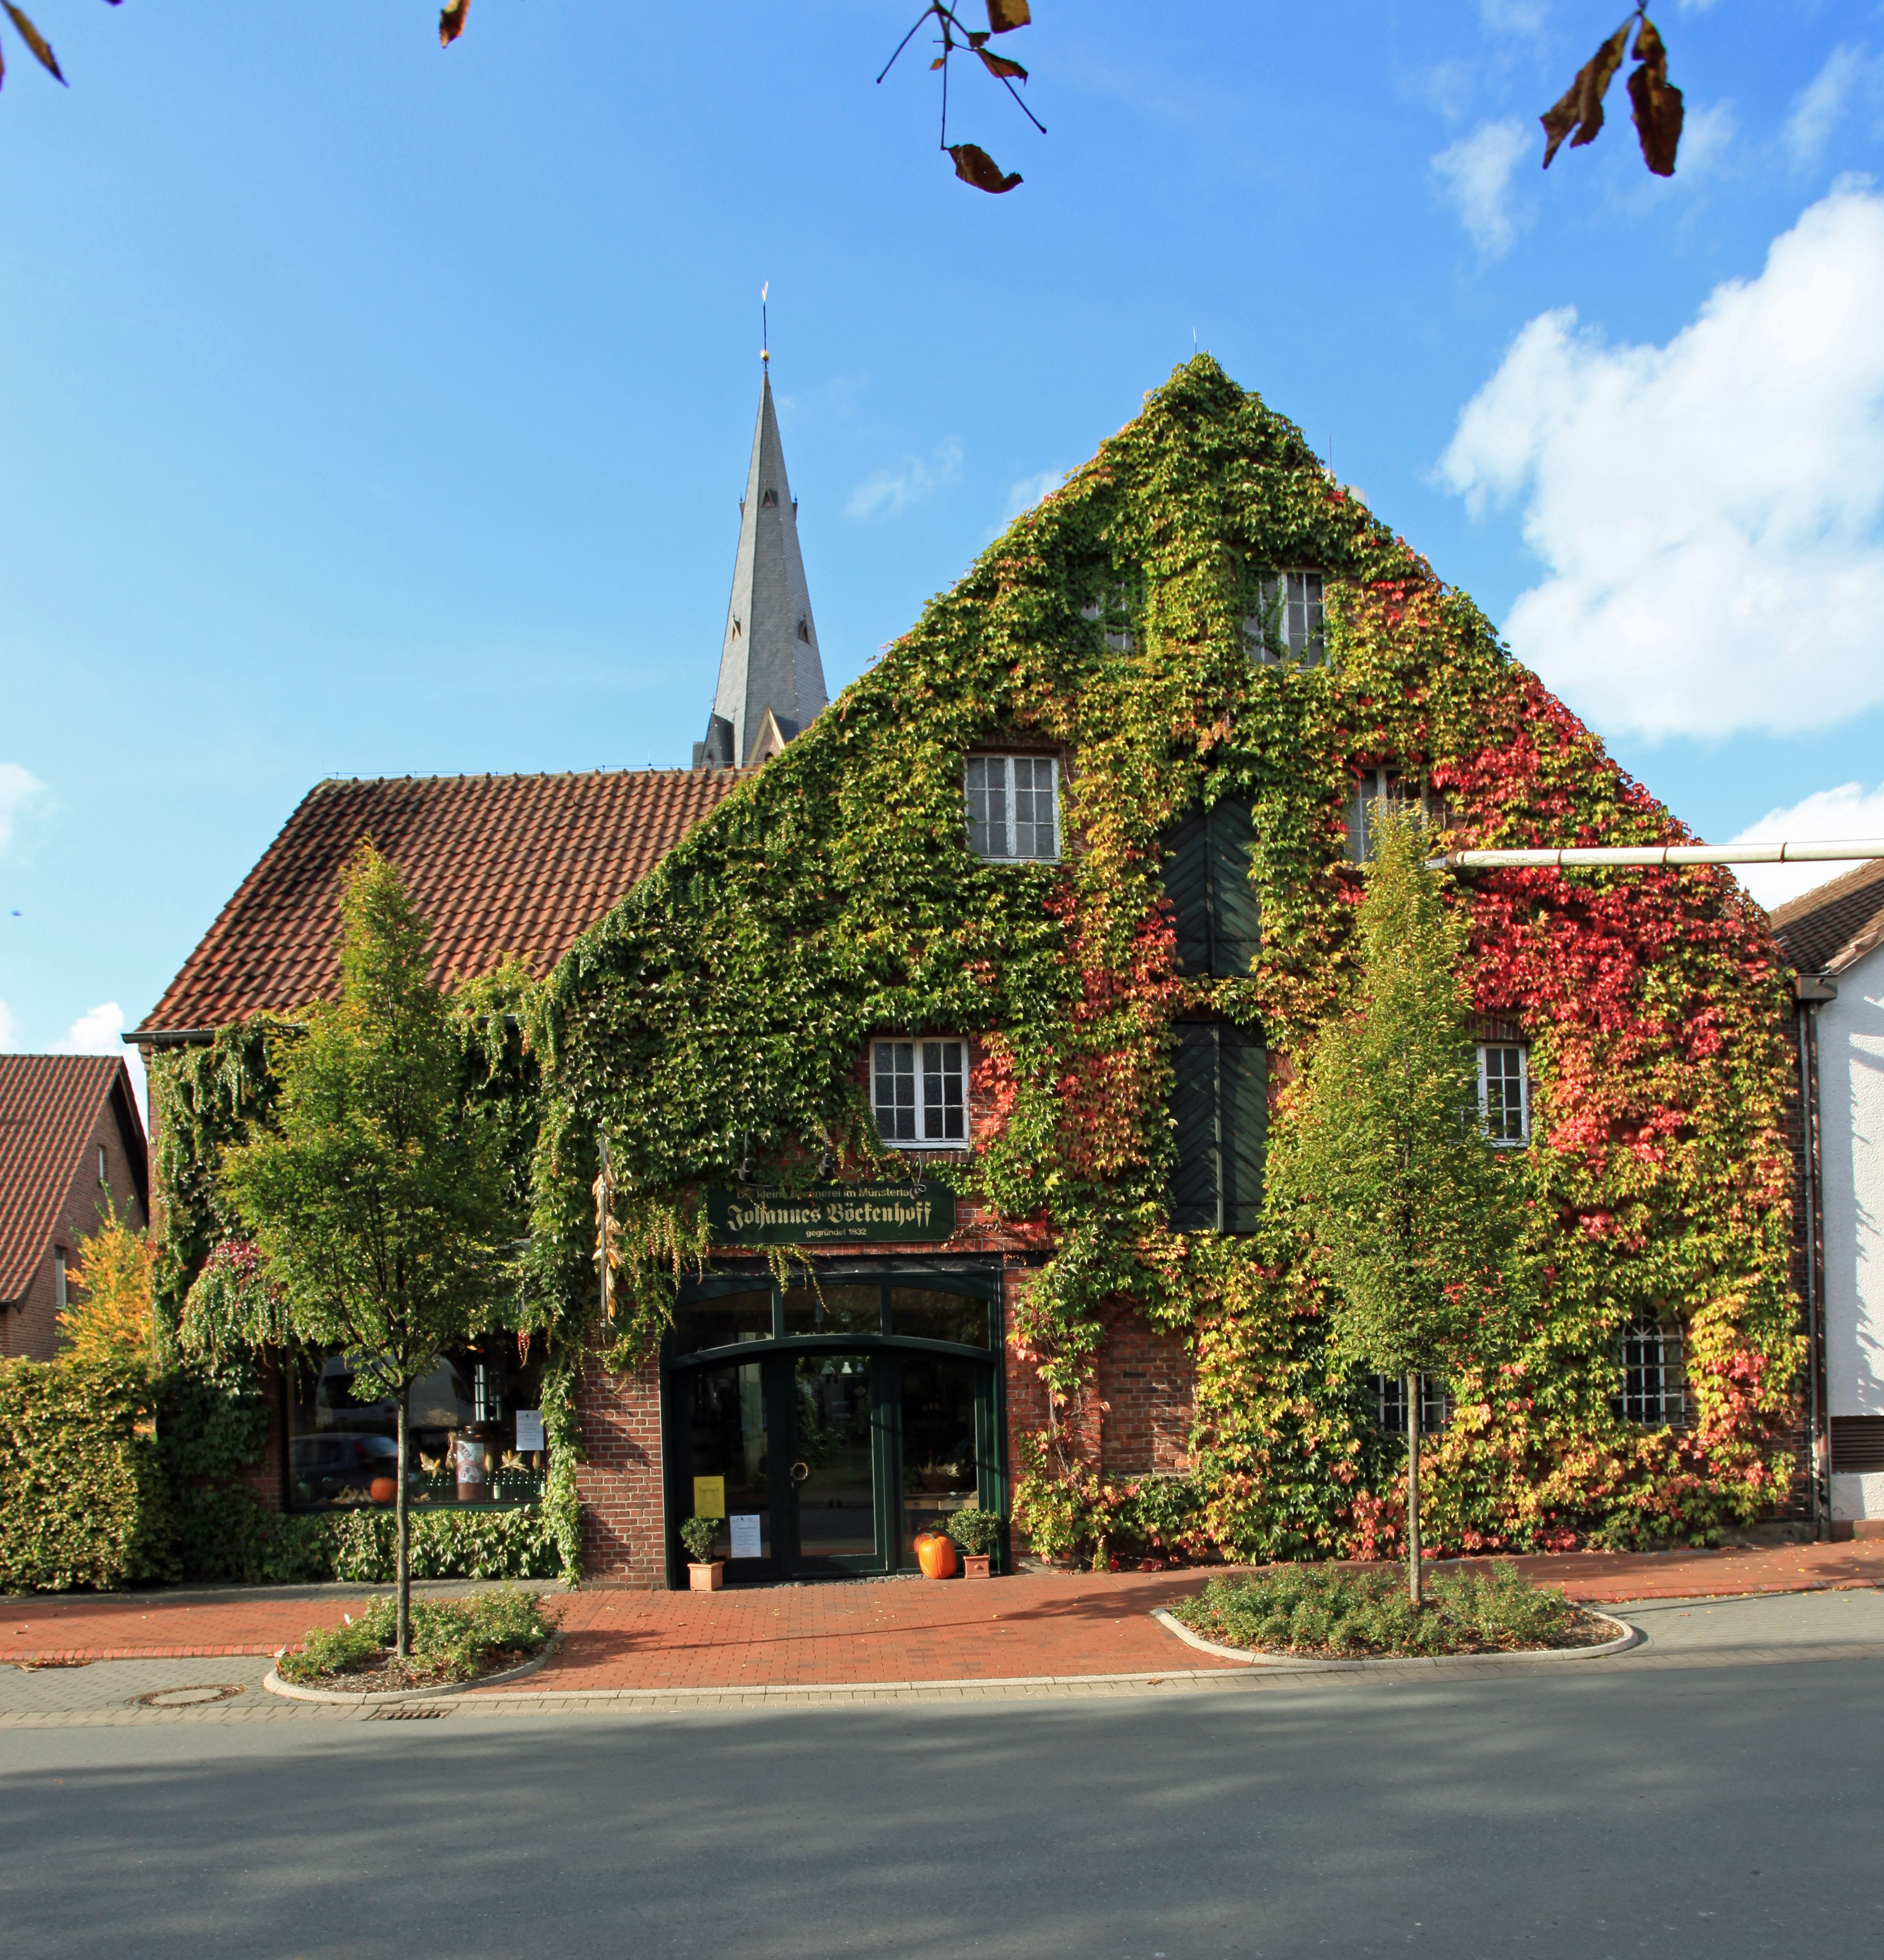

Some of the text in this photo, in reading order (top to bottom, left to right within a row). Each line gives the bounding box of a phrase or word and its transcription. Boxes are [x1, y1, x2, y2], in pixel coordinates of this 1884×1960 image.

[844, 1188, 856, 1197] im
[858, 1188, 921, 1197] Münsterla
[727, 1201, 931, 1231] Johannes Böckenhoff
[806, 1229, 846, 1238] gegründet
